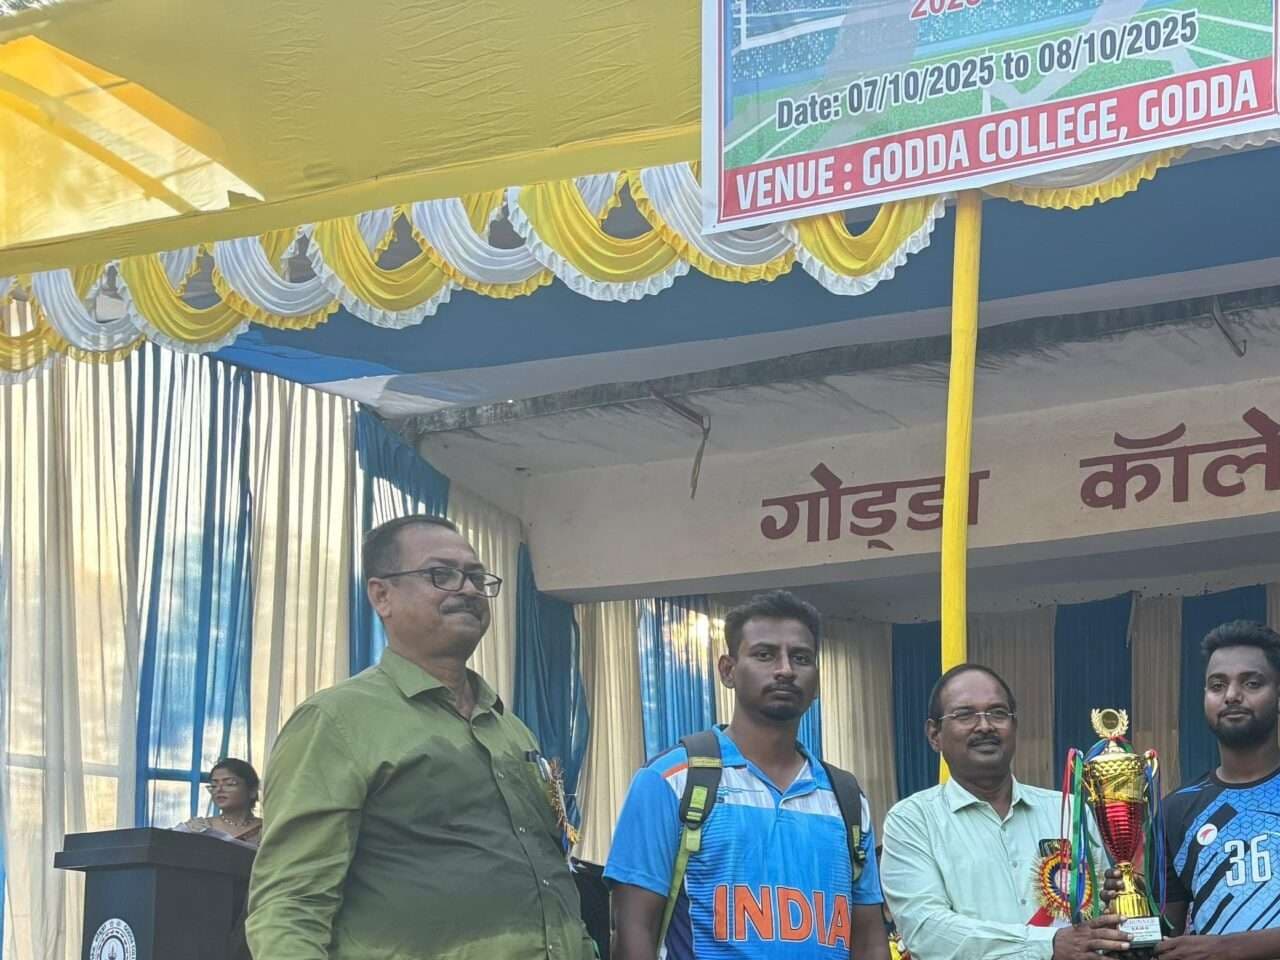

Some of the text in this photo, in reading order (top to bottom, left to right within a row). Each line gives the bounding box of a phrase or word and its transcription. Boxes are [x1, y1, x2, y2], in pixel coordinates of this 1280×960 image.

[776, 13, 1198, 130] Date: 07/10/2025 to 08/10/2025
[736, 156, 835, 210] VENUE
[862, 128, 970, 187] GODDA
[978, 97, 1129, 164] COLLEGE,
[1138, 69, 1259, 132] GODDA
[1224, 833, 1272, 888] 36
[713, 883, 852, 951] INDIA
